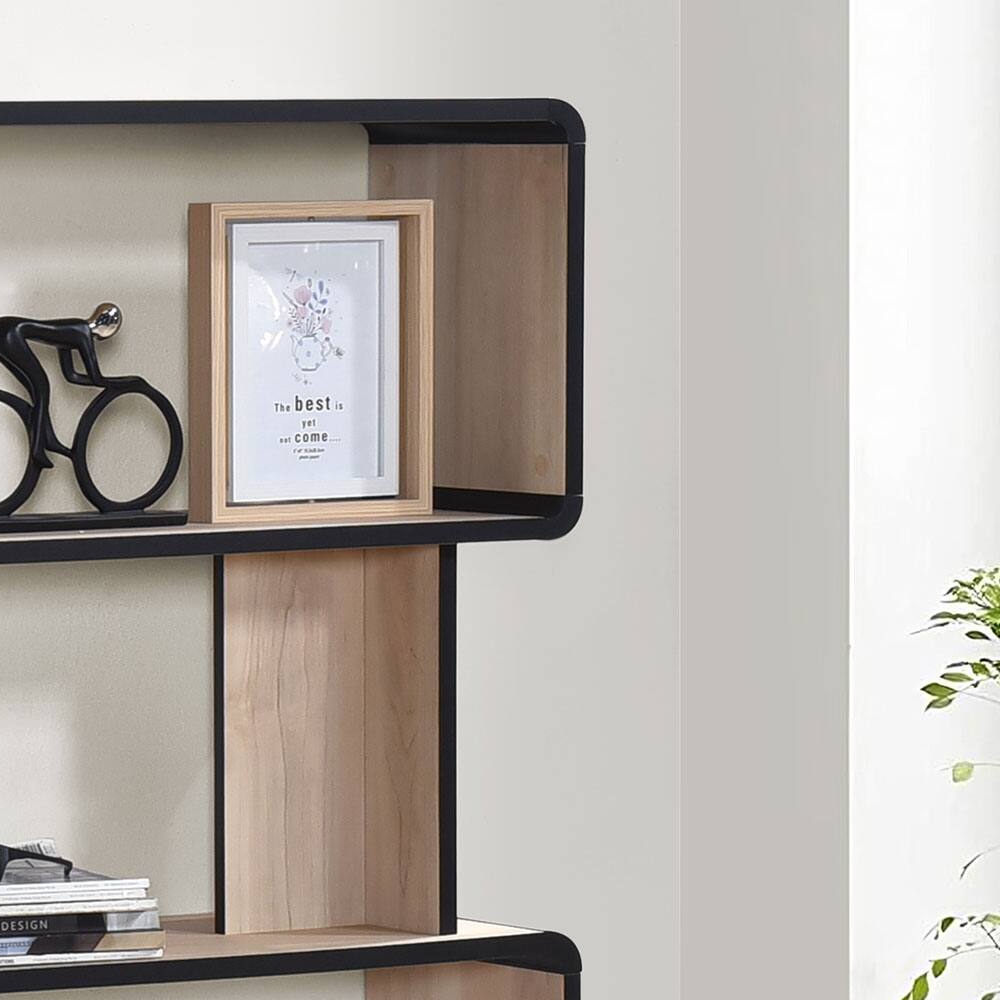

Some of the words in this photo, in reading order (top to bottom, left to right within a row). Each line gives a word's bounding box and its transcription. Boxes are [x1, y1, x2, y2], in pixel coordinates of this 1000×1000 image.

[274, 403, 291, 412] The
[295, 395, 330, 411] best
[335, 401, 343, 410] is
[302, 419, 316, 429] yet
[1, 919, 48, 932] DESIGN
